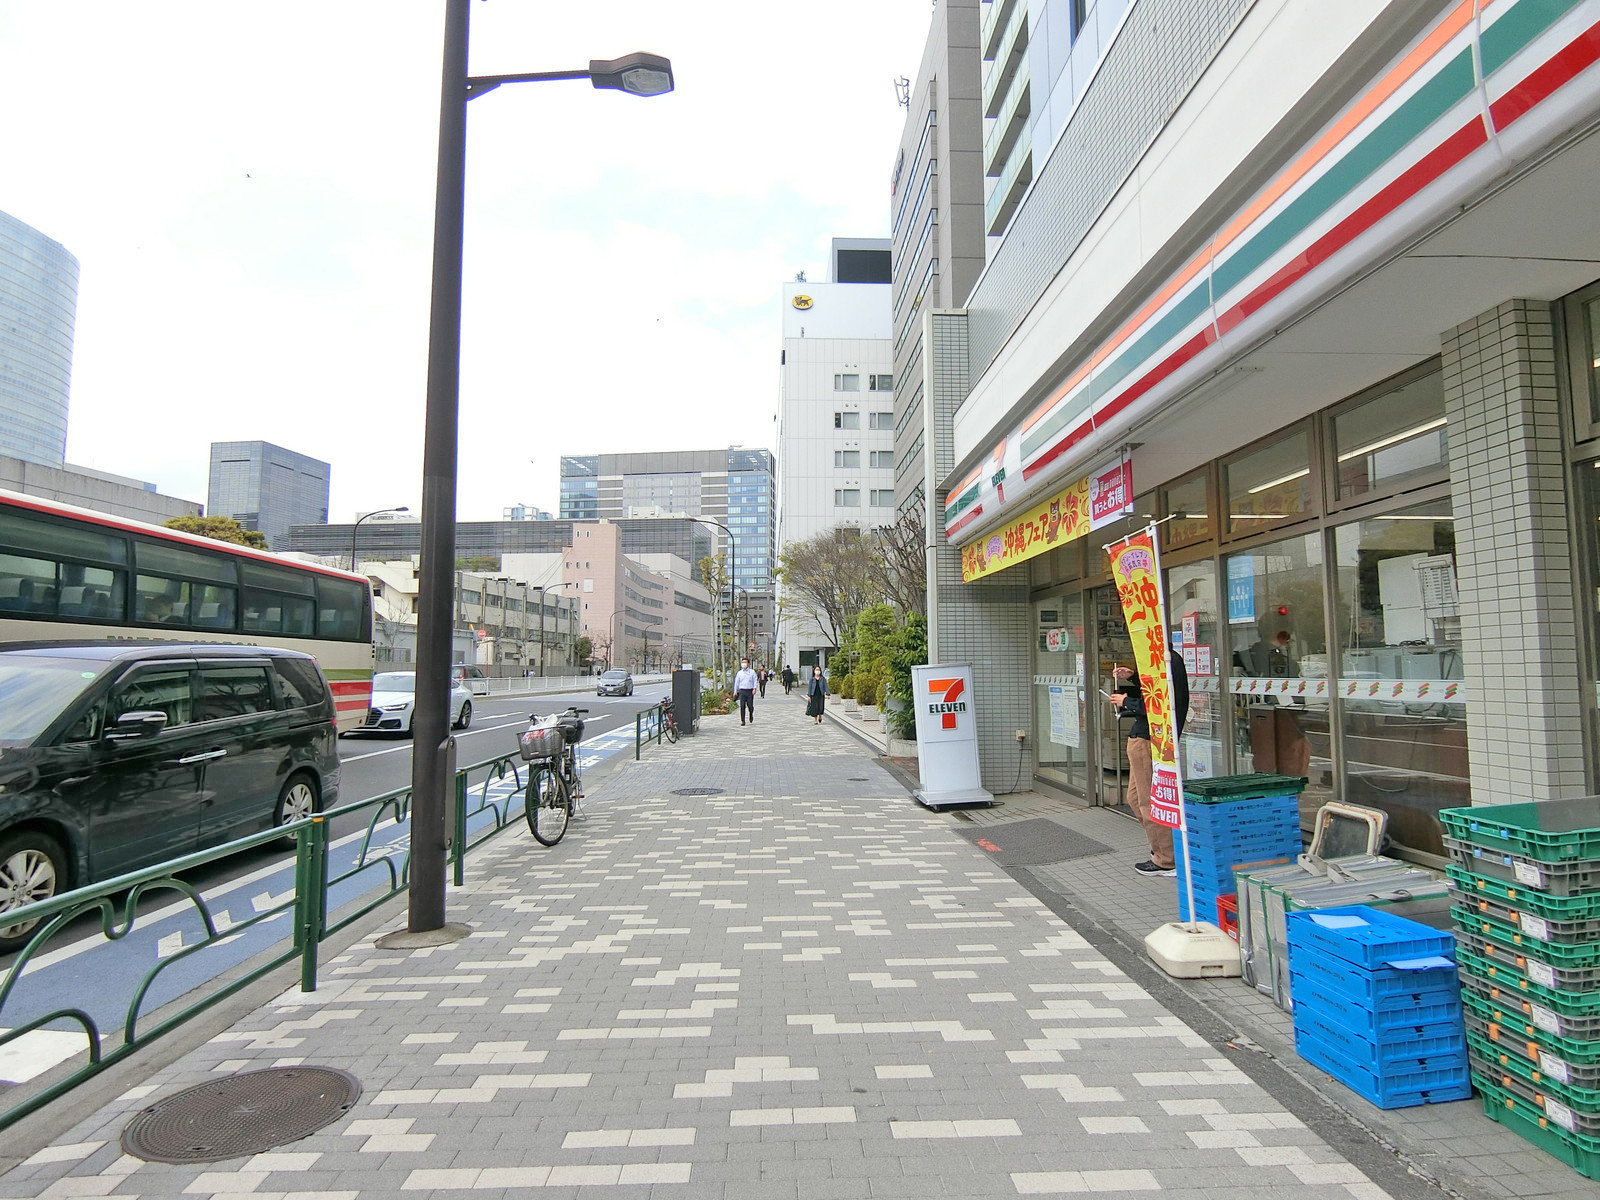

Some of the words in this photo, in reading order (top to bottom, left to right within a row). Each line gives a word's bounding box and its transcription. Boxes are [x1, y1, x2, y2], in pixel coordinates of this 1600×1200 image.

[1002, 513, 1049, 559] 沖縄フェア
